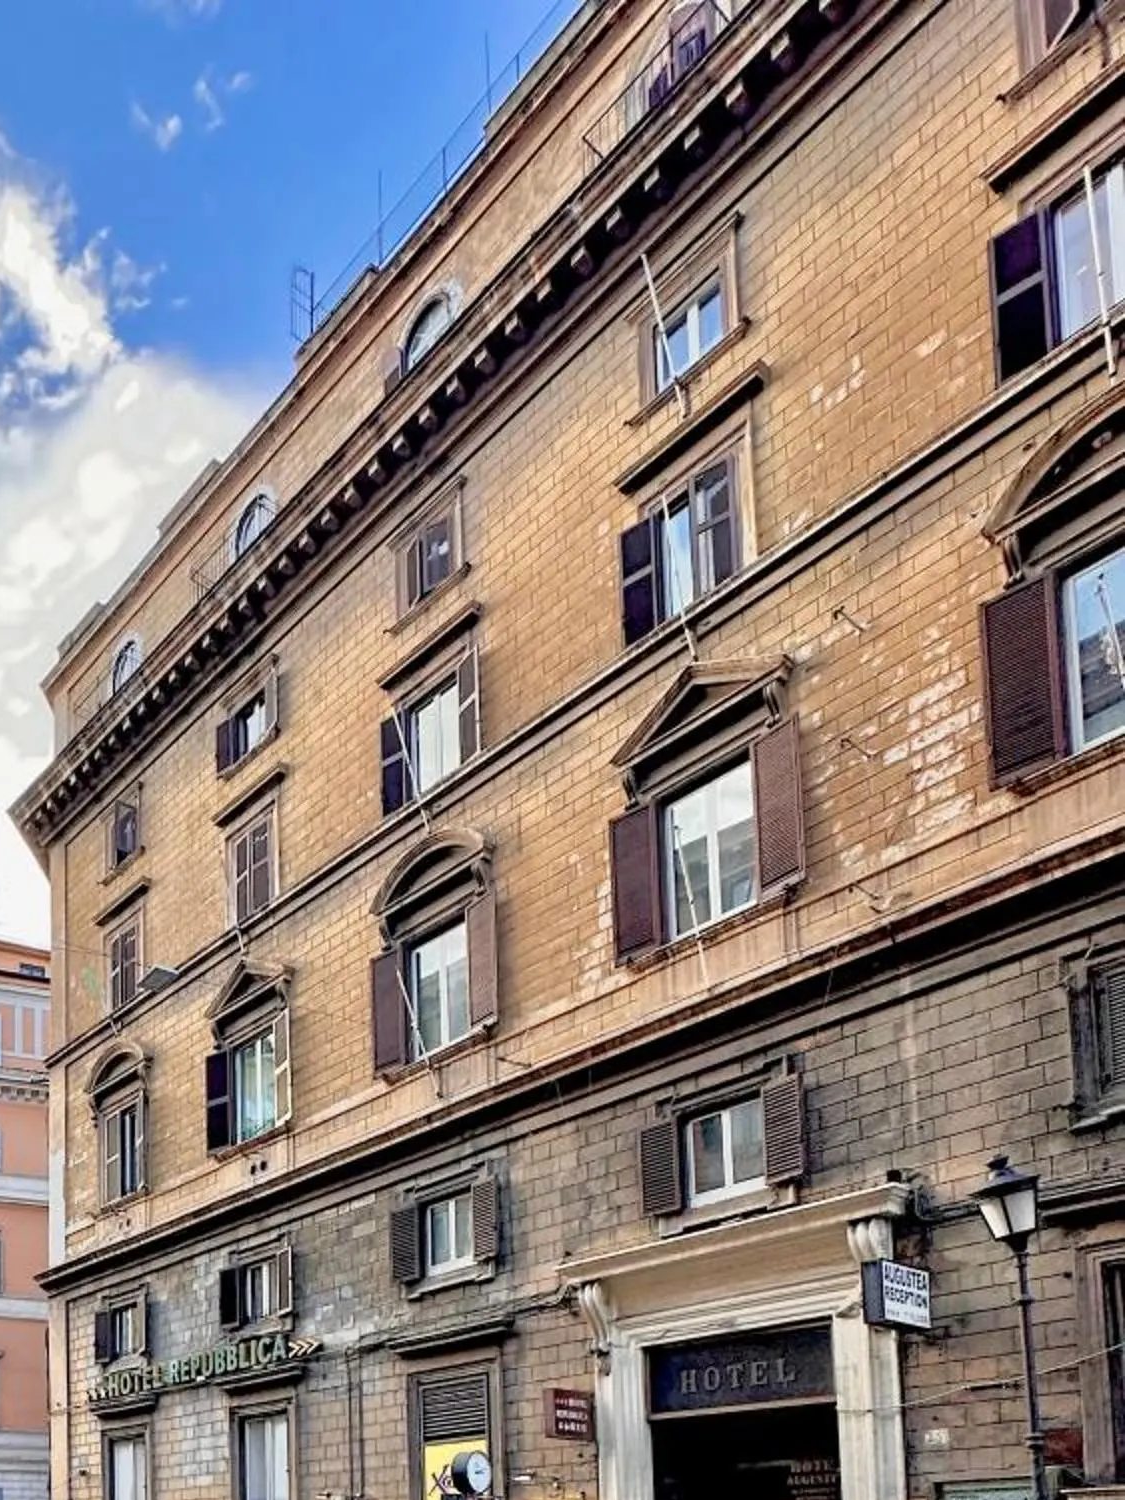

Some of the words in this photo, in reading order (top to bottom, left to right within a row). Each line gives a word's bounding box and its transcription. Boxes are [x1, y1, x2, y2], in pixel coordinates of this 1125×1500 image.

[884, 1263, 928, 1291] AUGUSTEA
[884, 1285, 928, 1309] RECEPTION
[107, 1366, 164, 1397] HOTEL
[168, 1334, 287, 1385] REPUBBLICA
[680, 1357, 796, 1394] HOTEL
